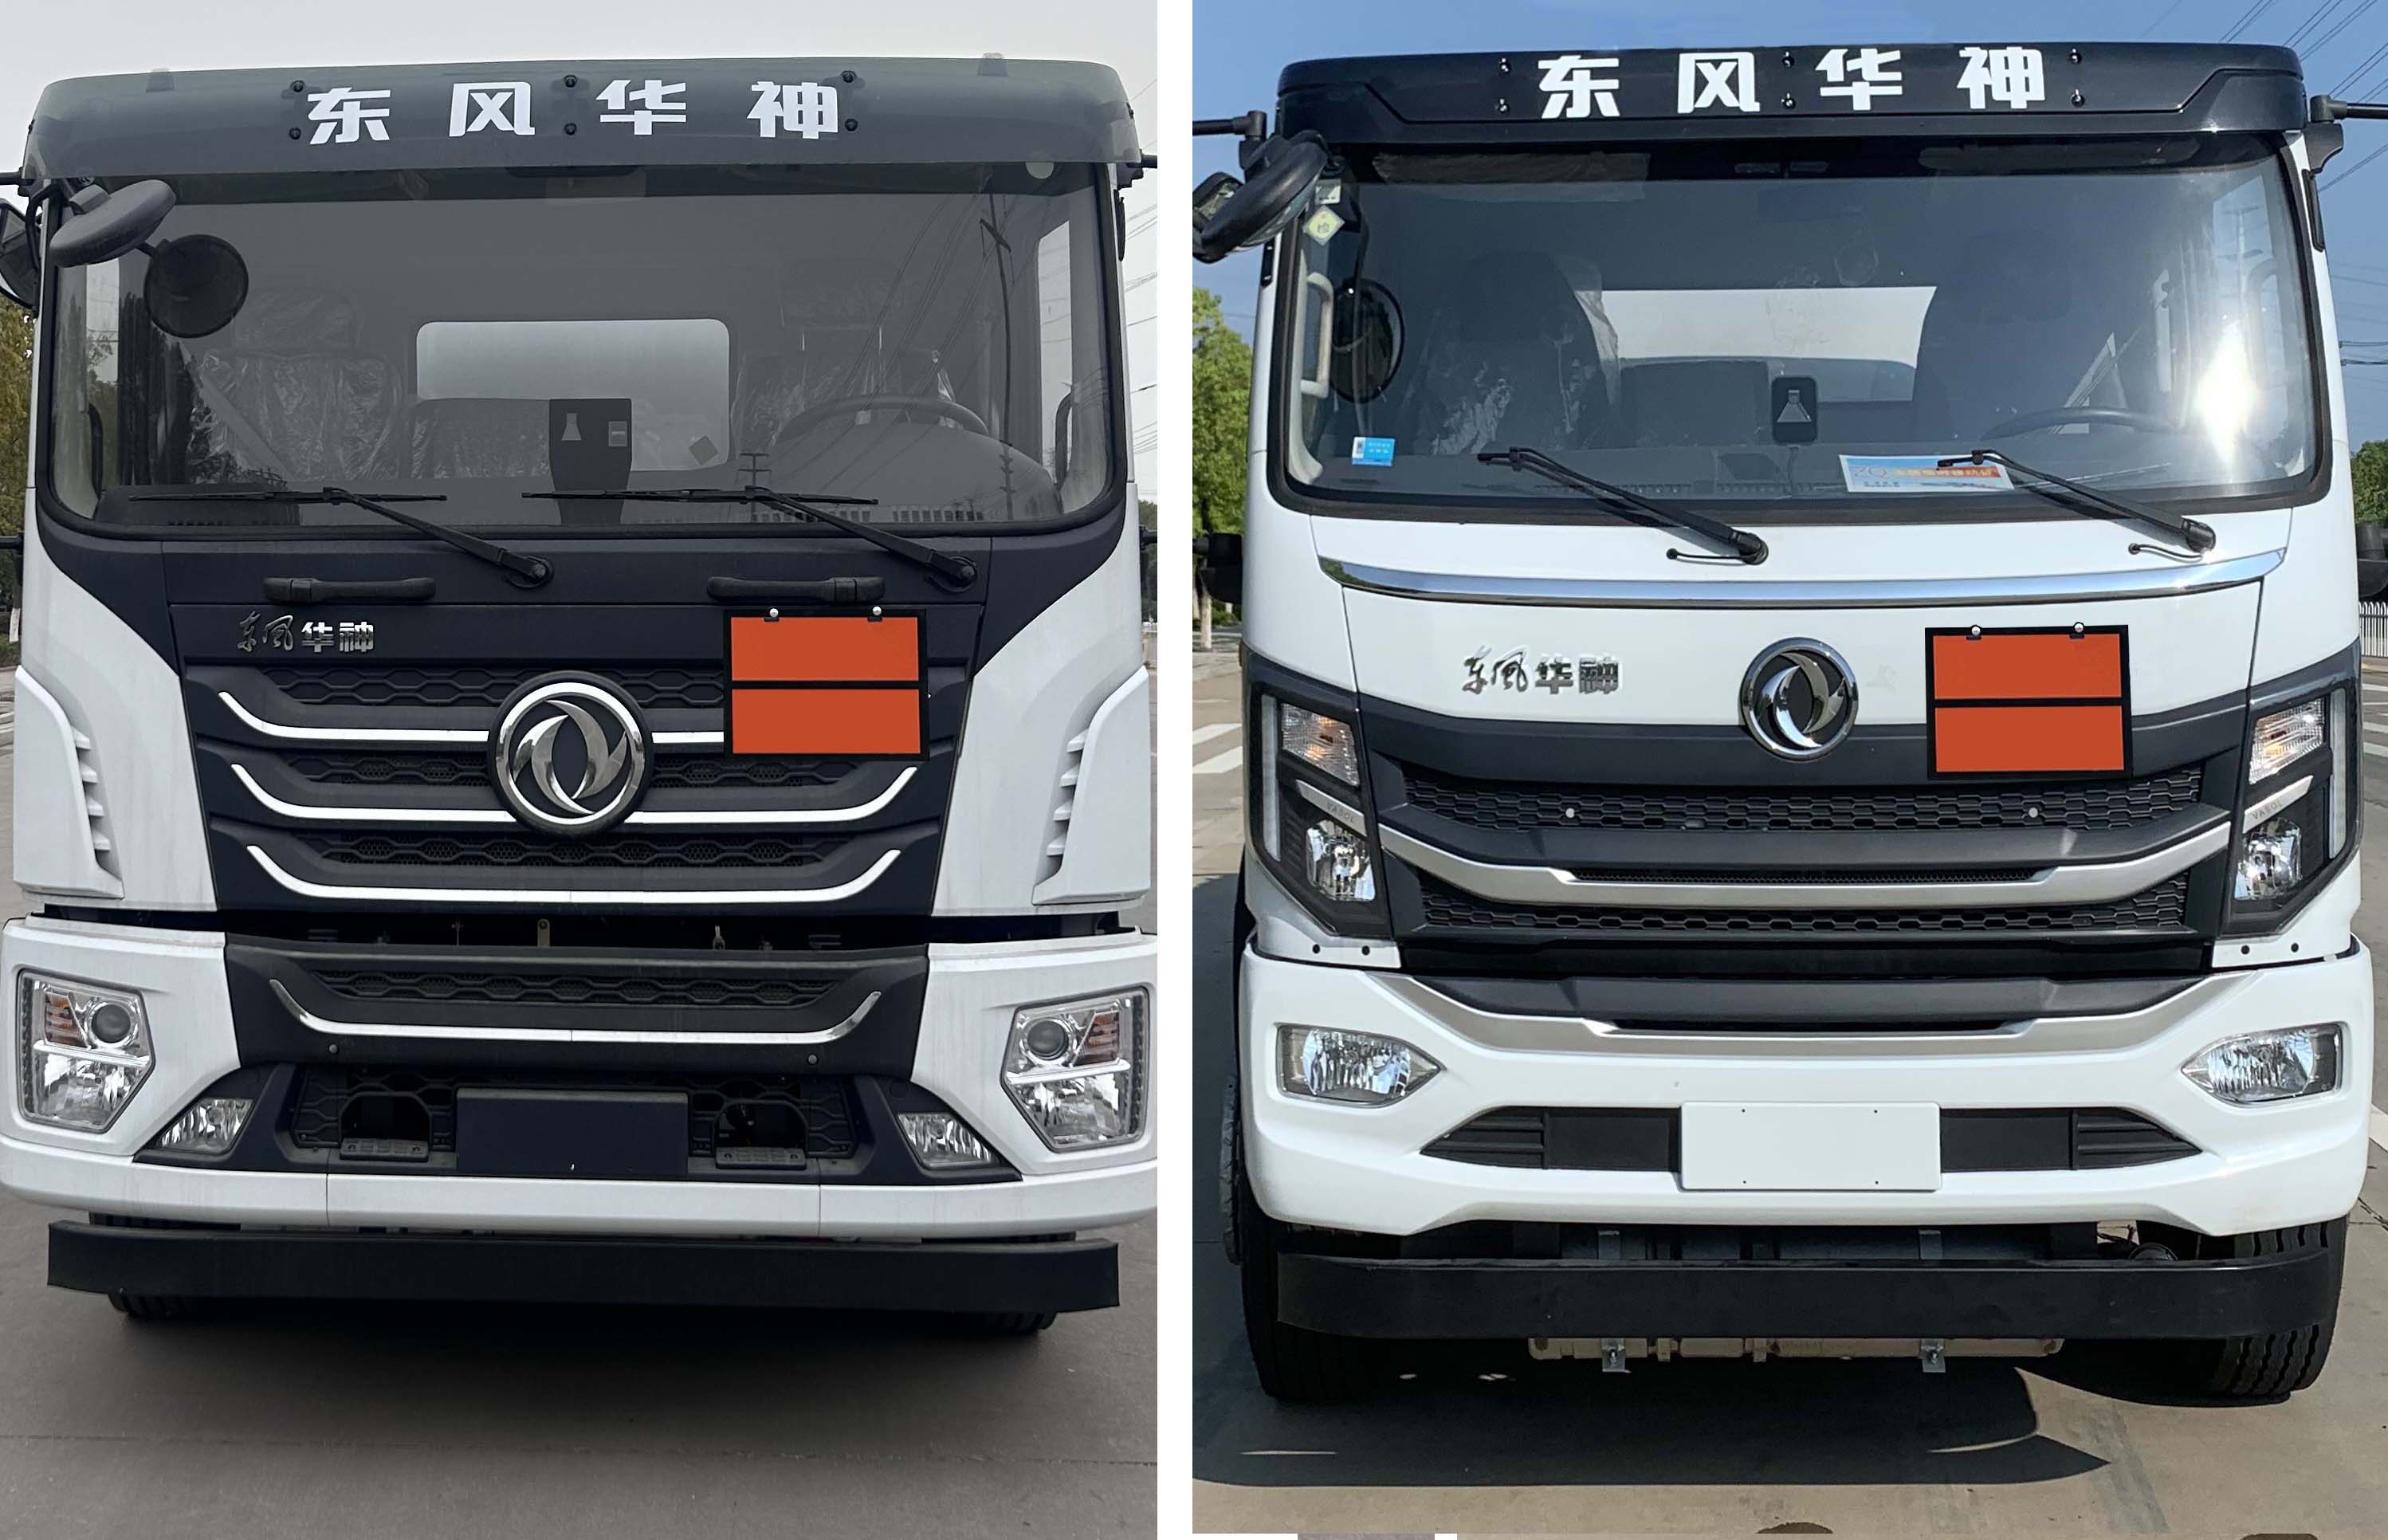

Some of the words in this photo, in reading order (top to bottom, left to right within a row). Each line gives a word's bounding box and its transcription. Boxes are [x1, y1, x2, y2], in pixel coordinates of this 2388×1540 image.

[307, 80, 839, 144] 东风华神
[1538, 46, 2045, 119] 东风华神
